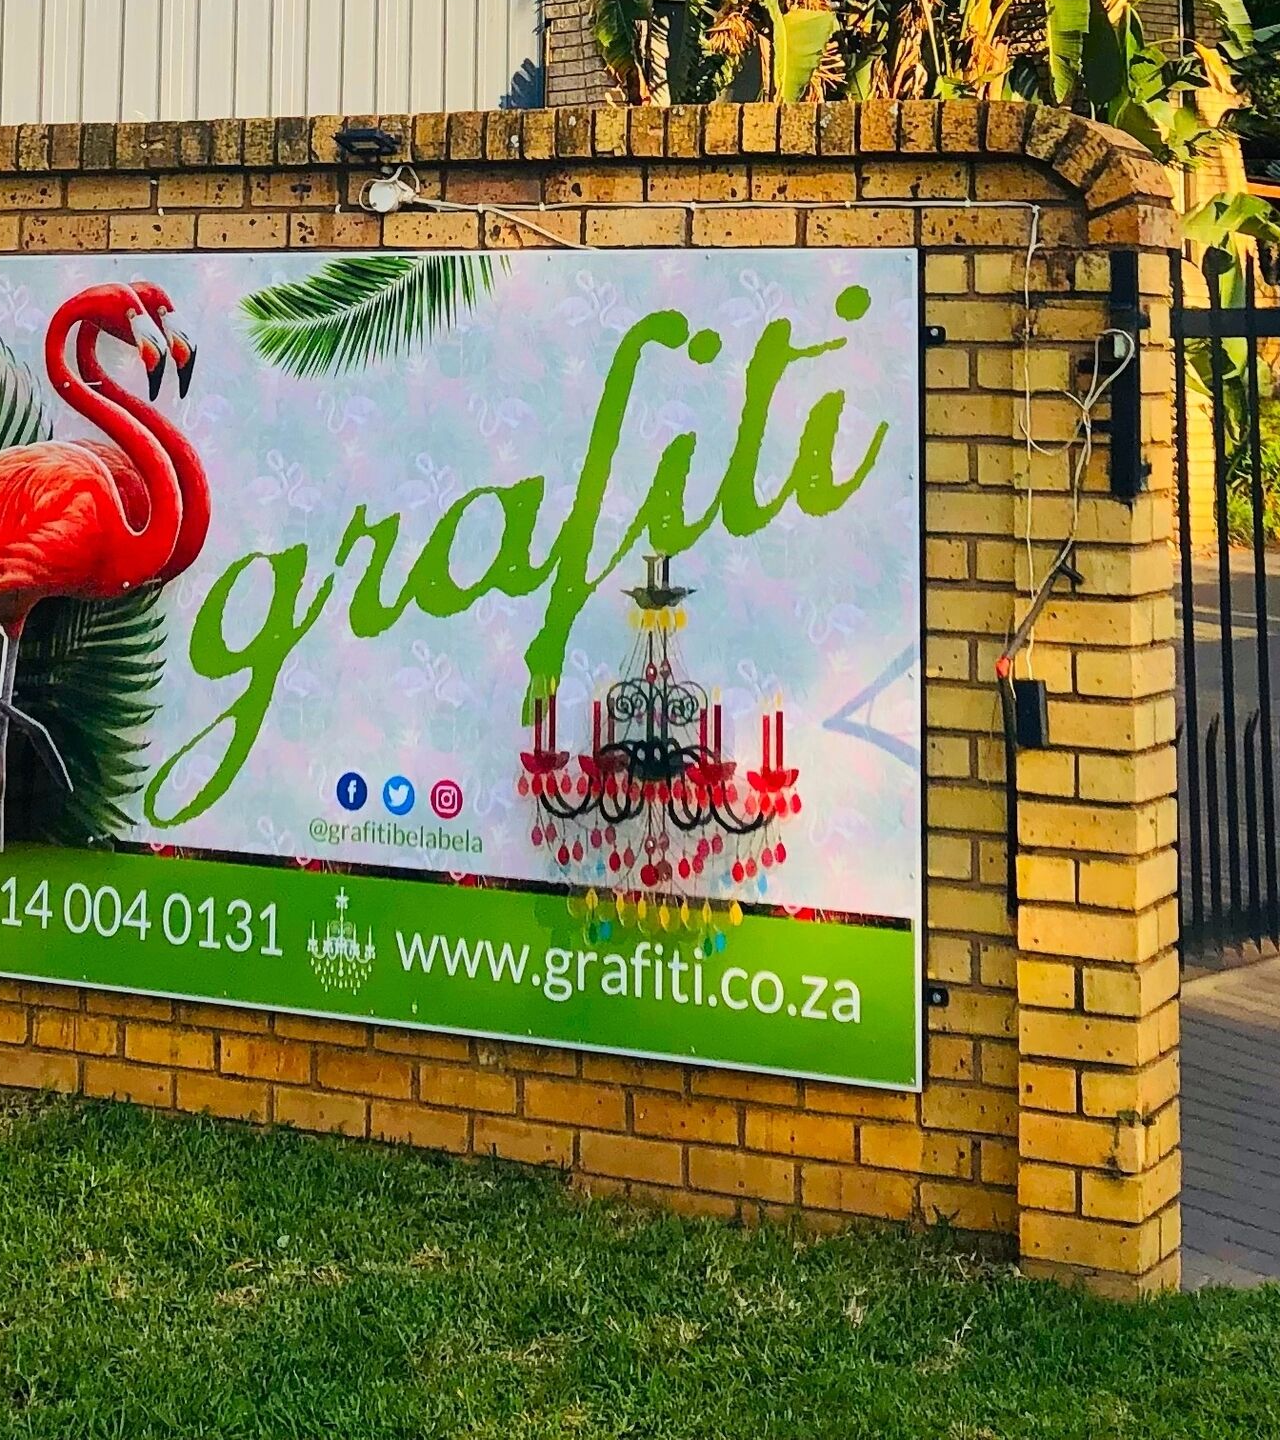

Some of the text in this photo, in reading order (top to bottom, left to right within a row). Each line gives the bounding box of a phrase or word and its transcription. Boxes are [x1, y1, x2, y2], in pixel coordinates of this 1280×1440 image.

[144, 284, 889, 829] grafiti
[308, 817, 483, 853] @grafitibelabela
[64, 882, 151, 941] 004
[163, 892, 283, 957] 0131
[395, 930, 862, 1024] www.grafiti.co.za
